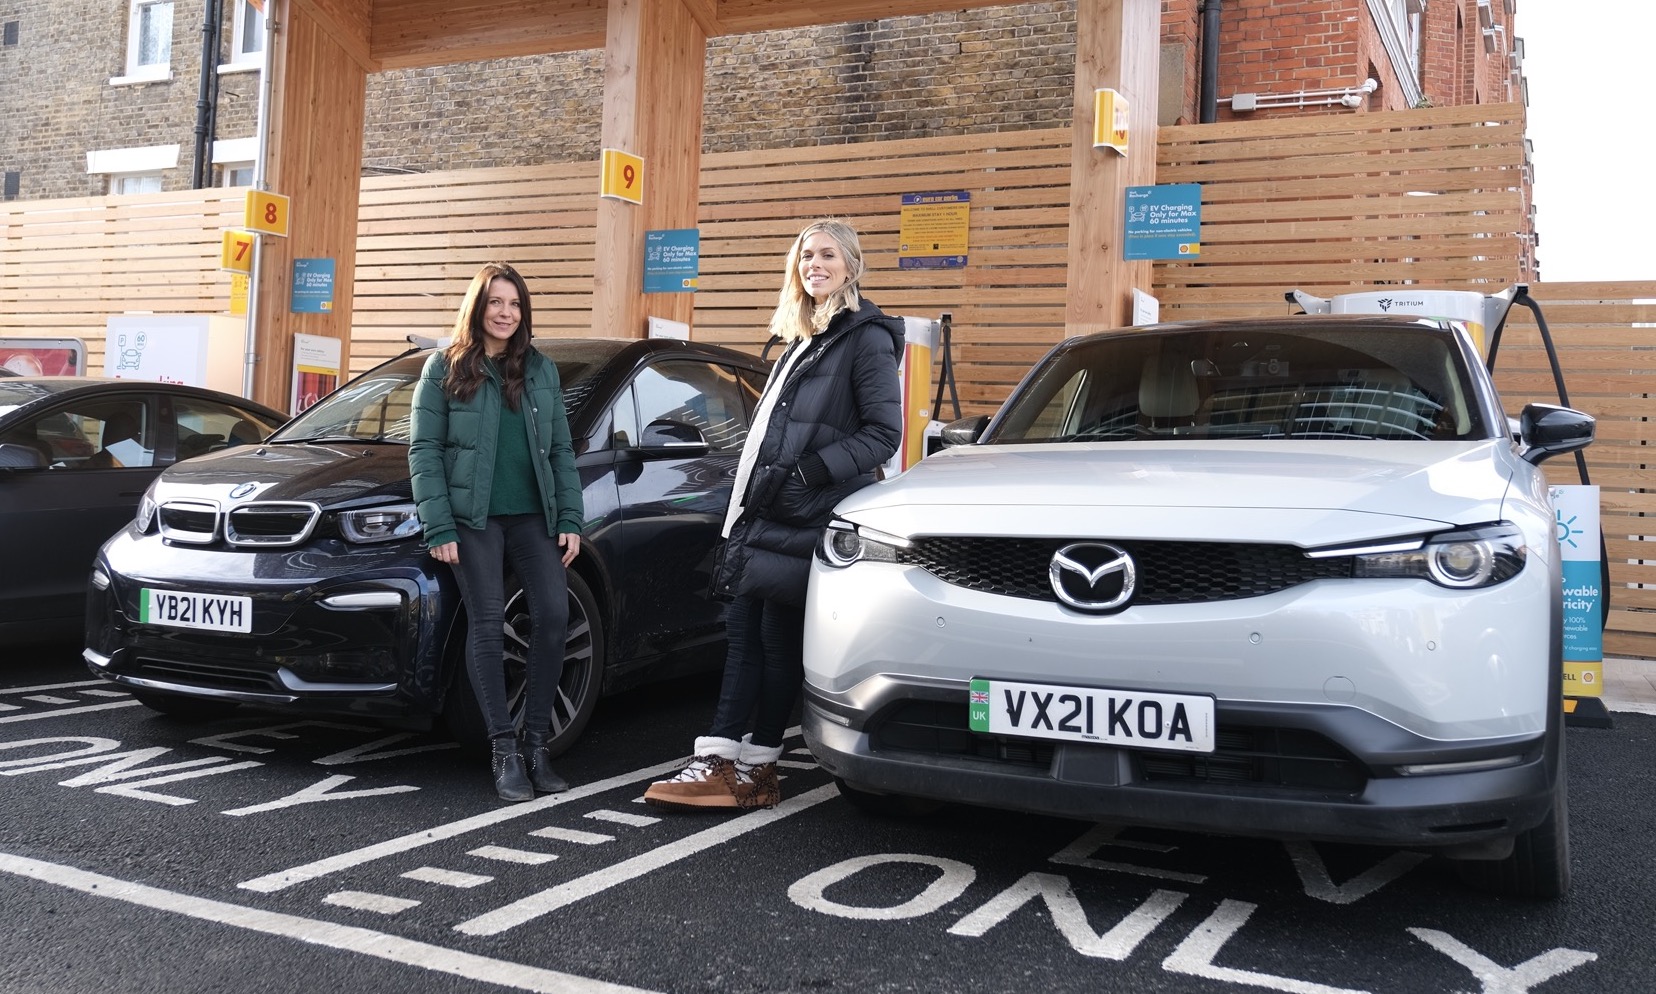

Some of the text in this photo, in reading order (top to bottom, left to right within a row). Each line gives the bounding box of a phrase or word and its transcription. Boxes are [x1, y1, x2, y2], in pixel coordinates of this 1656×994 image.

[623, 164, 635, 190] 9
[264, 202, 277, 224] 8
[1161, 204, 1193, 212] Charging
[235, 240, 250, 262] 7
[137, 334, 145, 342] 60
[156, 594, 243, 627] YB21 KYH
[1568, 616, 1586, 624] 100%
[972, 711, 987, 721] UK
[1003, 689, 1094, 735] VX21
[1107, 697, 1194, 743] KOA
[787, 853, 1599, 994] ONLY
